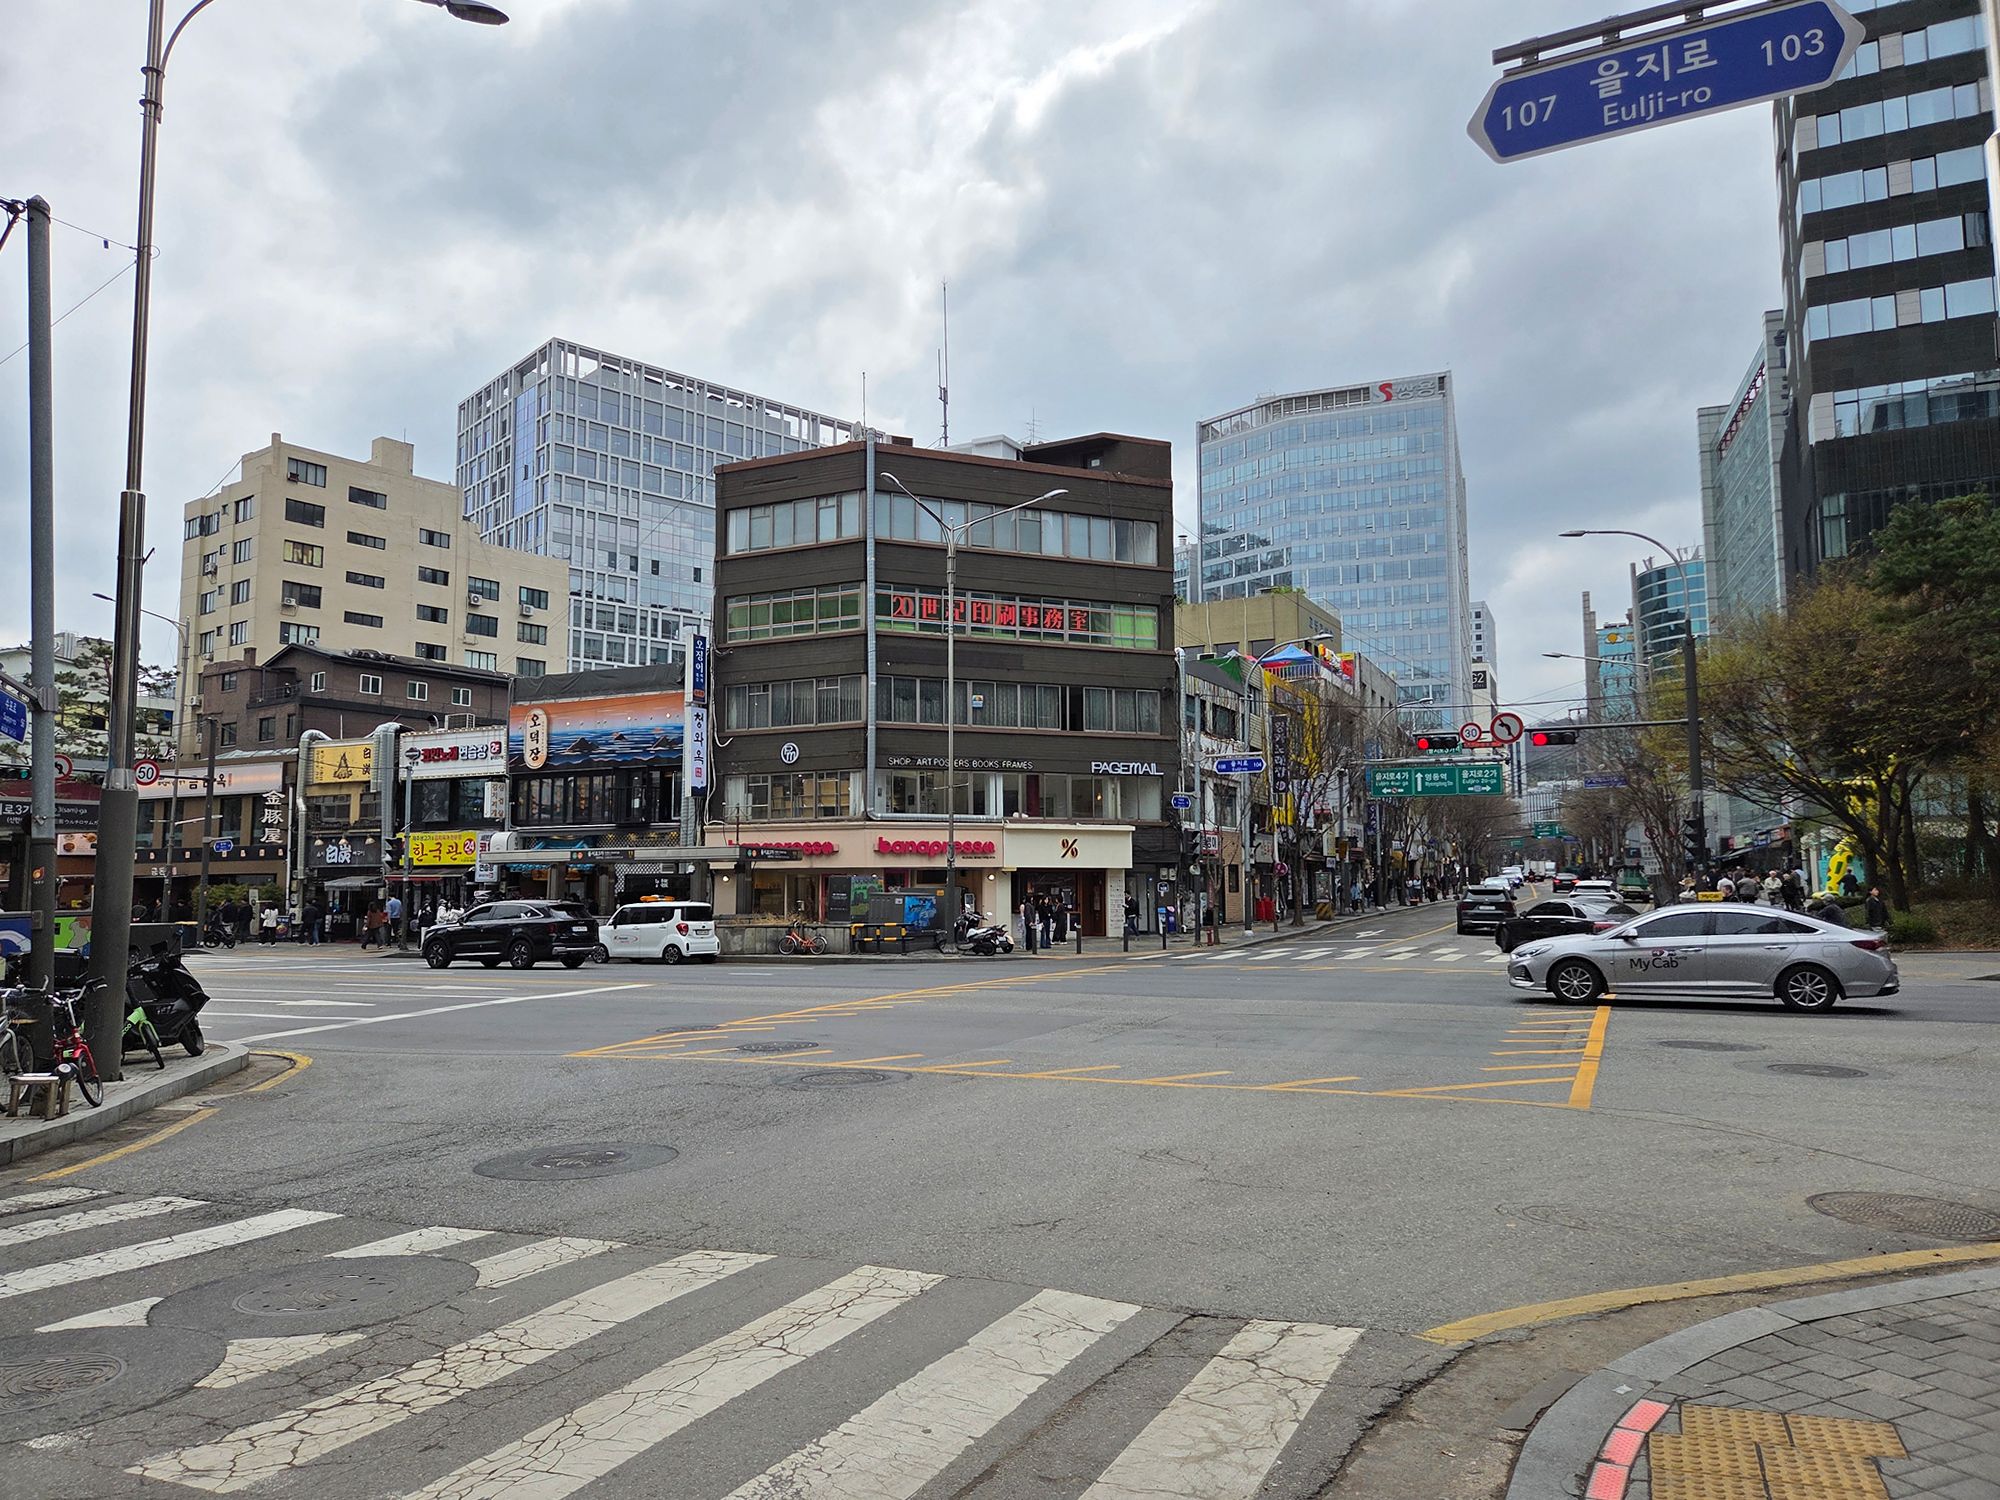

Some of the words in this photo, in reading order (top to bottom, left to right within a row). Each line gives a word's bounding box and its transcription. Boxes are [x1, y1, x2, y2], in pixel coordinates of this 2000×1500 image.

[1760, 28, 1826, 68] 103
[1589, 39, 1718, 100] 을지로
[1501, 94, 1557, 131] 107
[1602, 84, 1712, 127] Eulji-ro
[529, 713, 541, 761] 오덕장
[693, 712, 704, 765] 청와옥
[1464, 728, 1477, 738] 30
[888, 757, 911, 766] SHOP
[916, 758, 932, 767] ART
[933, 758, 970, 768] POSERS
[972, 759, 999, 769] BOOKS
[1002, 760, 1033, 770] FRAMES
[1090, 761, 1164, 776] PAGEMAIL
[138, 767, 154, 779] 50
[1375, 772, 1409, 780] 을지로4가
[1424, 773, 1448, 781] 명동역
[1461, 769, 1497, 778] 을지로2가
[260, 790, 285, 844] 金豚屋
[413, 842, 462, 862] 한국관
[1652, 957, 1679, 968] Cab
